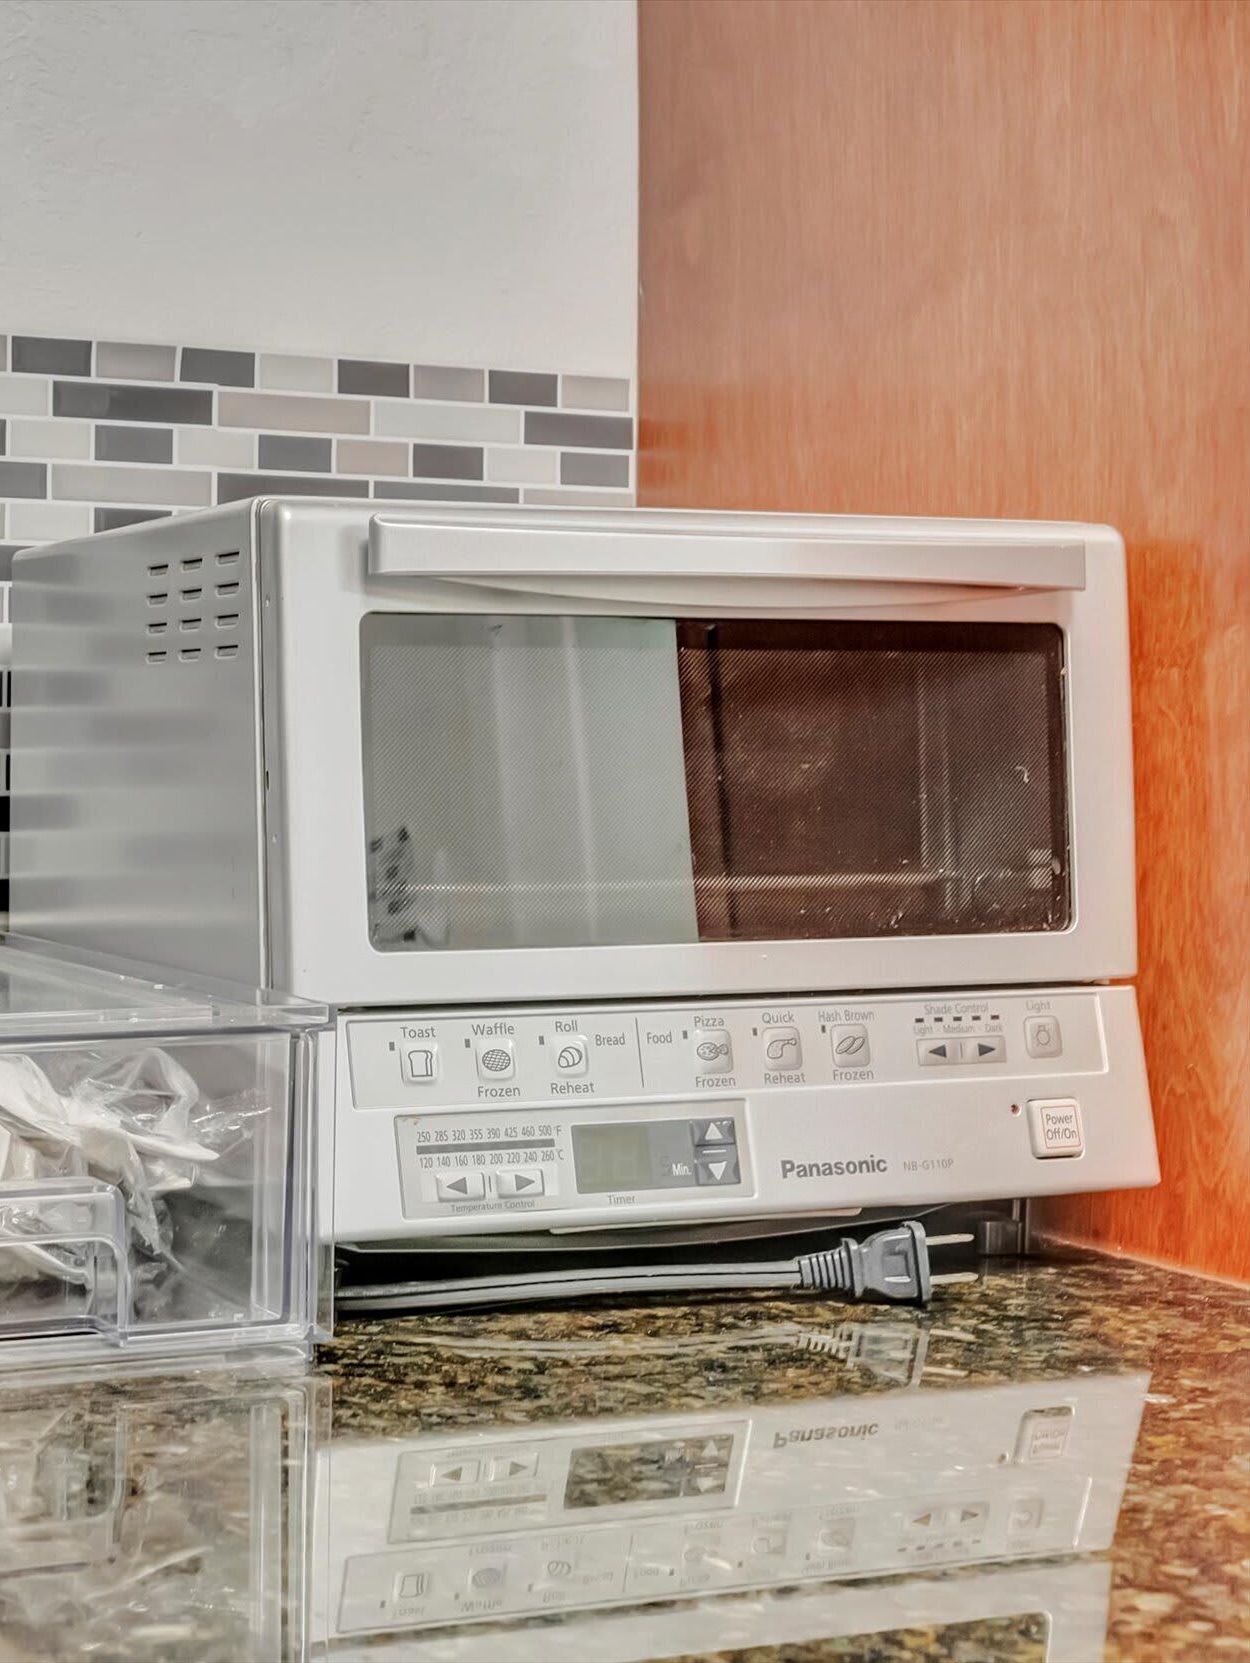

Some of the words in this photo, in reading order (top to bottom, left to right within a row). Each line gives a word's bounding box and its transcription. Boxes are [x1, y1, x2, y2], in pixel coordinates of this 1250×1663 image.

[924, 1003, 952, 1015] Shade
[954, 1002, 989, 1014] Control
[1025, 1000, 1051, 1013] Light
[694, 1015, 725, 1028] Pizza
[761, 1011, 795, 1025] Quick
[817, 1009, 842, 1022] Hash
[844, 1009, 875, 1021] Brown
[400, 1026, 437, 1039] Toast
[471, 1022, 515, 1036] Waffle
[555, 1020, 579, 1033] Roll
[595, 1033, 626, 1047] Bread
[646, 1030, 673, 1044] Food
[695, 1075, 736, 1088] Frozen
[764, 1072, 806, 1085] Reheat
[832, 1069, 875, 1081] Frozen
[478, 1085, 521, 1098] Frozen
[550, 1081, 595, 1094] Reheat
[1046, 1113, 1074, 1125] Power
[417, 1131, 431, 1143] 250
[434, 1130, 449, 1142] 285
[452, 1129, 466, 1141] 320
[469, 1128, 483, 1140] 355
[487, 1127, 501, 1139] 390
[504, 1127, 518, 1138] 425
[521, 1126, 535, 1137] 460
[538, 1125, 552, 1136] 500
[1046, 1128, 1078, 1141] Off/On
[419, 1157, 433, 1168] 120
[437, 1156, 451, 1168] 140
[455, 1155, 469, 1167] 160
[472, 1154, 486, 1166] 180
[489, 1153, 503, 1165] 200
[507, 1152, 521, 1164] 220
[524, 1151, 538, 1163] 240
[541, 1150, 555, 1162] 260
[671, 1162, 692, 1176] Min.
[780, 1154, 888, 1179] Panasonic
[606, 1193, 637, 1206] Timer
[451, 1203, 502, 1214] Temperature
[504, 1200, 536, 1210] Control
